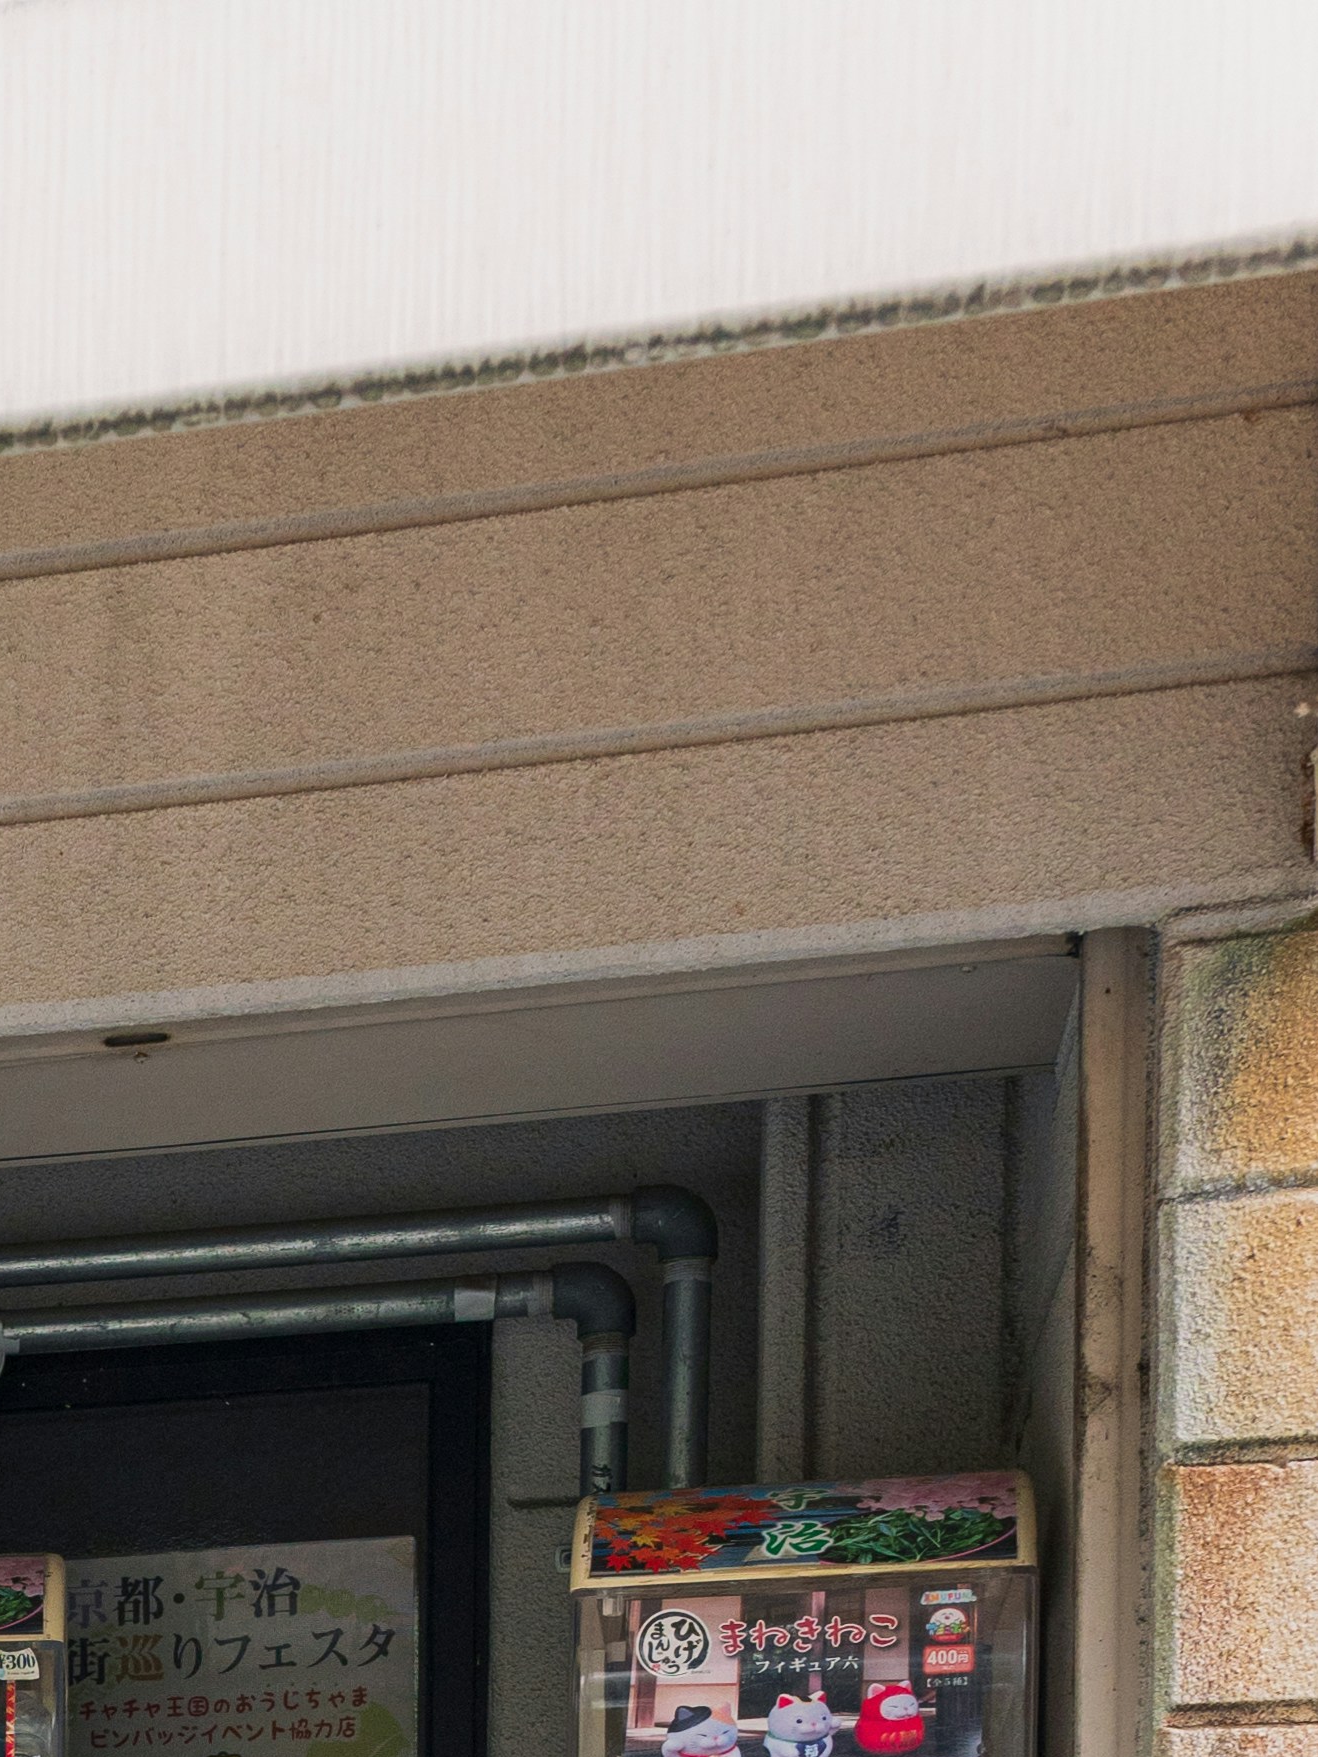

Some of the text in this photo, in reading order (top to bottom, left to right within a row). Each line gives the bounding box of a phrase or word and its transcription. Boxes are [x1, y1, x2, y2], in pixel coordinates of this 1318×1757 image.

[718, 1614, 899, 1657] まねきねこ
[66, 1624, 397, 1687] 街巡りフェスタ
[754, 1656, 861, 1674] フィギュア六
[926, 1649, 970, 1668] 400円
[79, 1685, 369, 1720] チャチャ王国のおうじちゃま
[90, 1716, 357, 1750] ピンバッジイベント協力店
